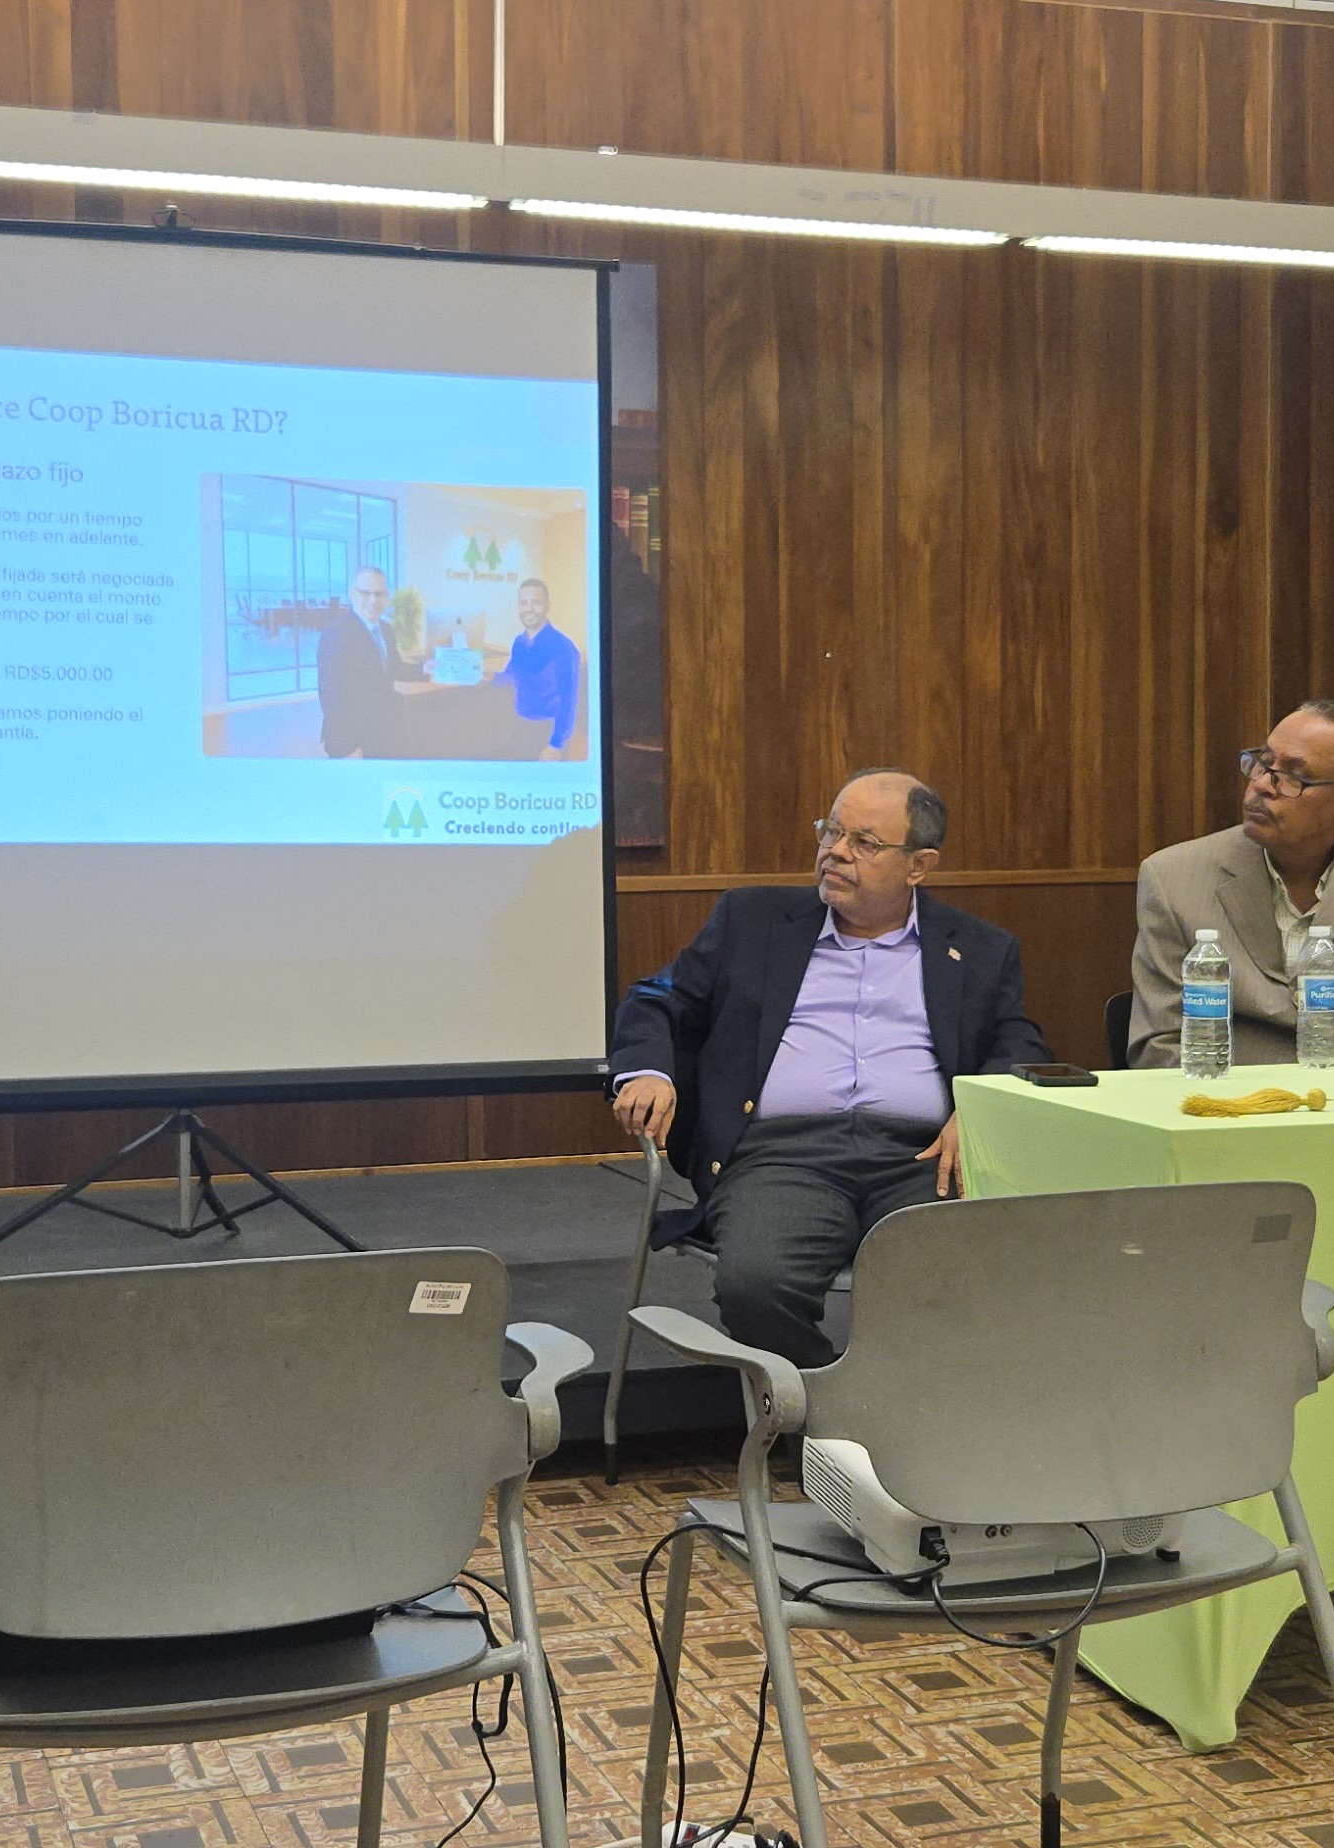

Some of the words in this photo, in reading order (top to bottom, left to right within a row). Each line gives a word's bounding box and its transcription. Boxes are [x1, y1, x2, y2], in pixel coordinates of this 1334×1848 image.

[28, 396, 104, 431] Coop
[111, 400, 225, 431] Boricua
[231, 407, 289, 434] RD?
[48, 461, 84, 488] fijo
[26, 510, 54, 525] por
[59, 512, 80, 524] un
[84, 510, 143, 529] tiempo
[2, 529, 38, 542] mes
[43, 531, 64, 544] en
[69, 529, 144, 548] adelante.
[2, 567, 46, 585] fijada
[51, 569, 86, 585] será
[91, 571, 175, 588] negociada
[1, 588, 22, 602] en
[27, 588, 84, 604] cuenta
[87, 589, 103, 604] el
[107, 591, 162, 606] monto
[44, 609, 72, 625] por
[76, 608, 91, 624] el
[95, 609, 129, 625] cual
[134, 613, 155, 626] se
[47, 707, 124, 723] poniendo
[128, 707, 144, 722] el
[438, 790, 490, 815] Coop
[495, 791, 566, 811] Boricua
[571, 792, 598, 810] RD
[445, 820, 525, 836] Creciendo
[1204, 997, 1227, 1006] Water
